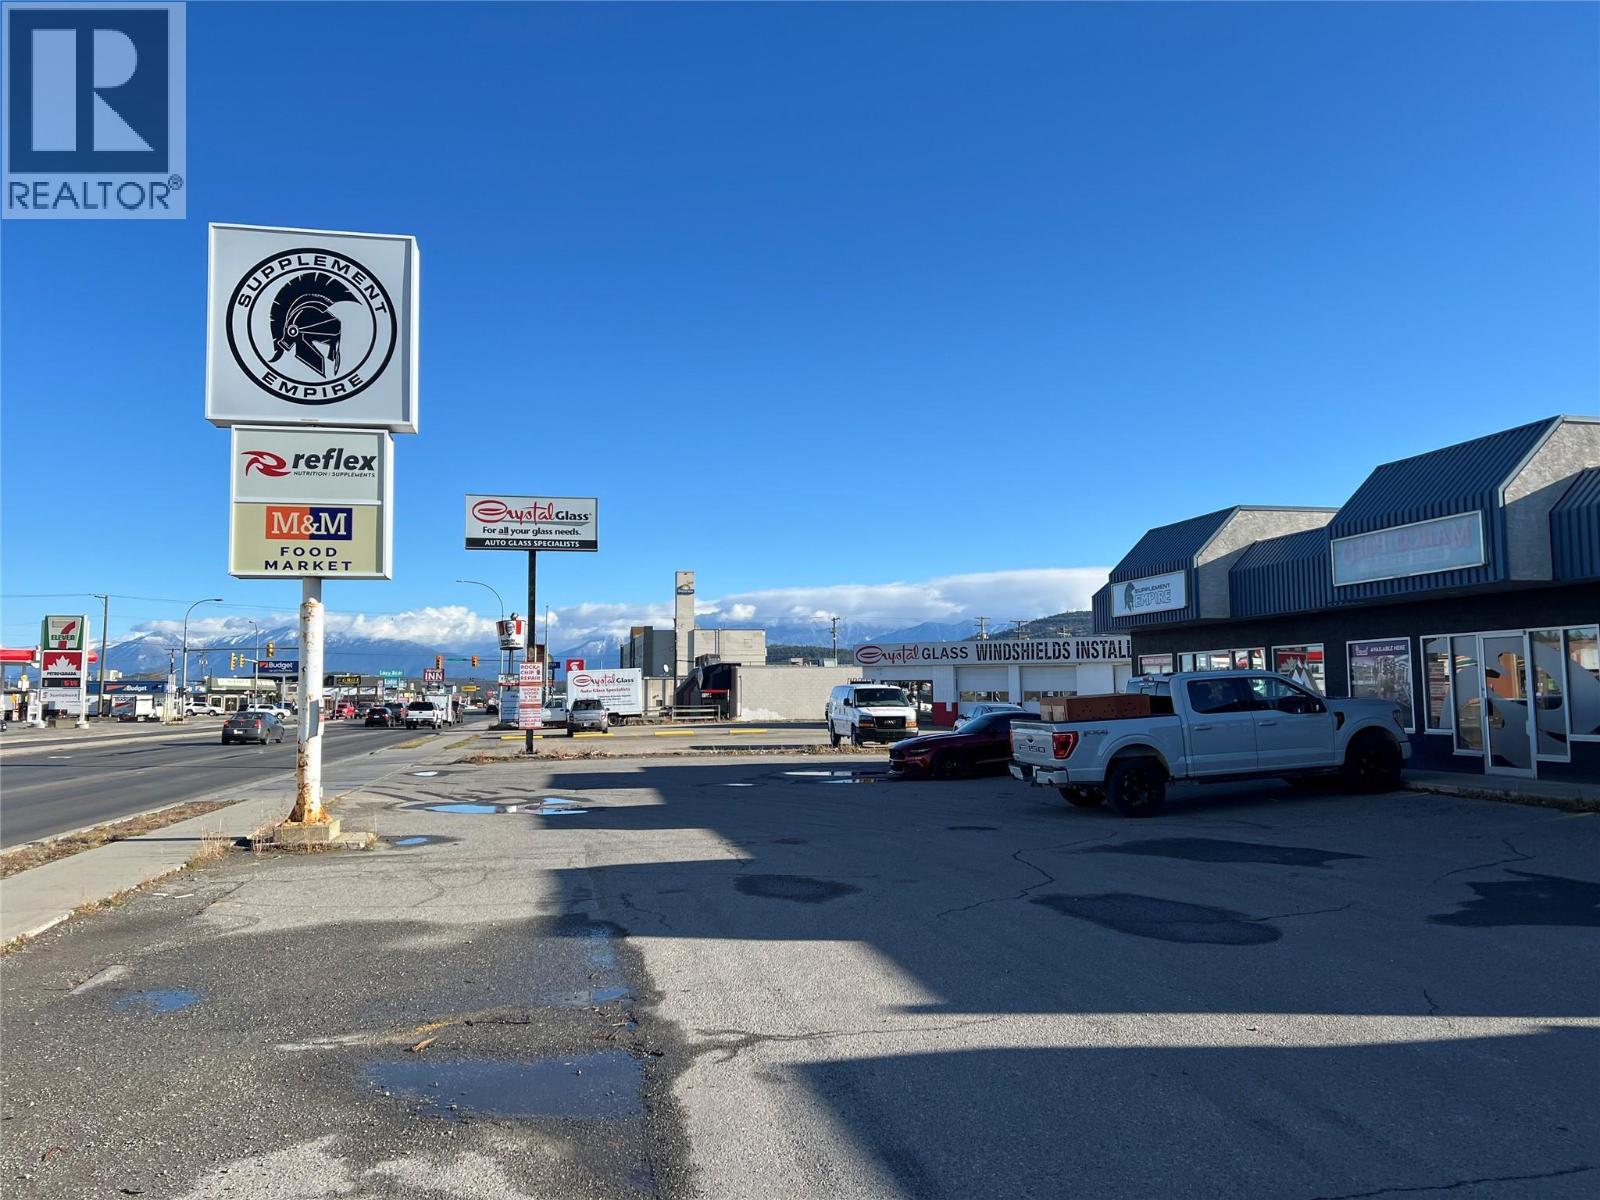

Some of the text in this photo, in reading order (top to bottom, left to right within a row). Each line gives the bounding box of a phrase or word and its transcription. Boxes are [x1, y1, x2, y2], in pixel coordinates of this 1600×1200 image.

[237, 255, 388, 314] SUPPLEMENT
[261, 371, 364, 398] EMPIRE
[291, 448, 377, 471] reflex
[472, 499, 555, 526] Crystal
[271, 511, 347, 535] M&M
[482, 526, 581, 536] For all your glass needs.
[508, 539, 532, 547] GLASS
[533, 540, 580, 548] SPECIALISTS
[280, 547, 337, 557] FOOD
[264, 560, 352, 571] MARKET
[1134, 583, 1170, 594] SUPPLEMENT
[1135, 590, 1172, 608] EMPIRE
[856, 644, 920, 664] Crystal
[921, 646, 969, 660] GLASS
[975, 641, 1071, 661] WINDSHIELDS
[269, 662, 293, 670] Budget
[425, 672, 443, 680] INN
